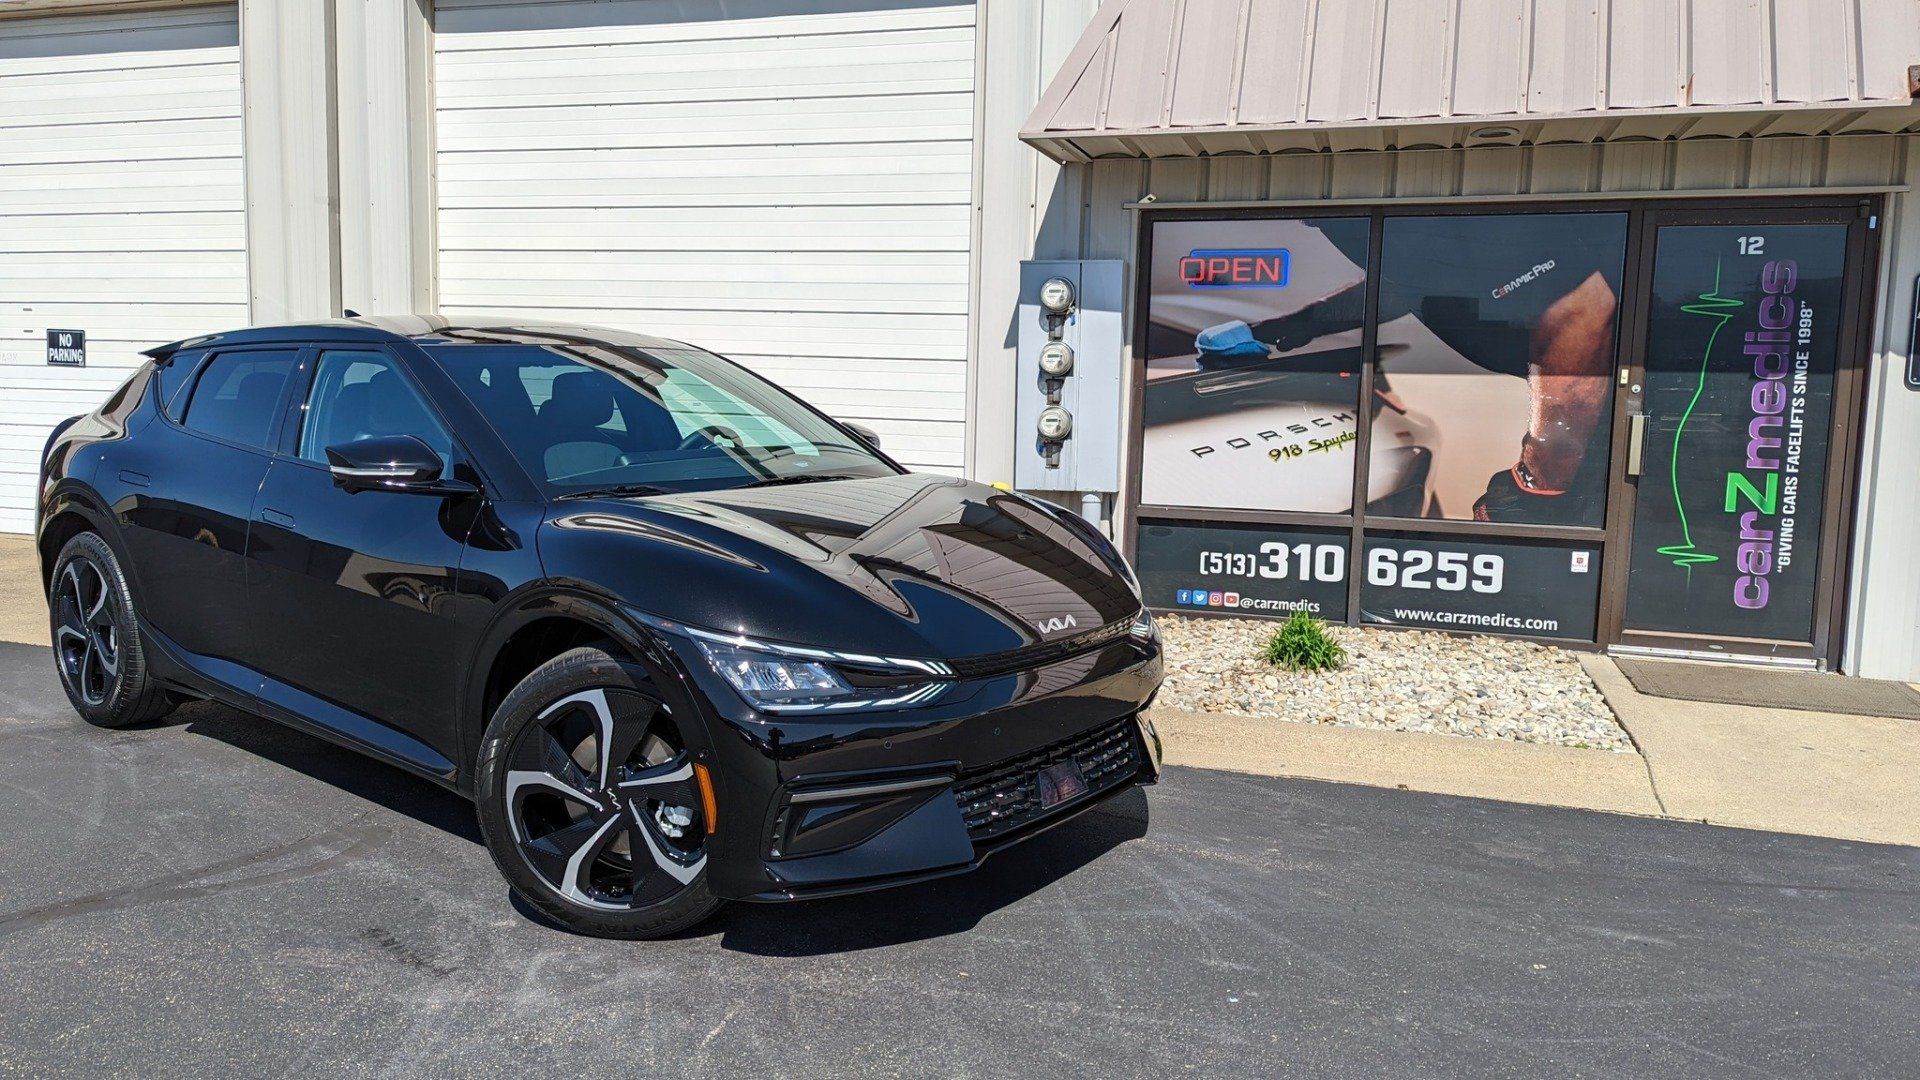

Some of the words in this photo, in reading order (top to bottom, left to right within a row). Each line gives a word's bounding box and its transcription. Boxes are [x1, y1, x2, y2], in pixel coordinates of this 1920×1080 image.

[1737, 236, 1765, 255] 12
[1179, 257, 1280, 283] OPEN
[59, 333, 72, 347] NO
[48, 347, 83, 362] PARKING
[1793, 350, 1810, 394] SINCE
[1190, 409, 1357, 459] PORSCH
[1786, 396, 1804, 473] FACELIFTS
[1268, 444, 1303, 462] 918
[1782, 474, 1798, 515] CARS
[1259, 541, 1345, 582] 310
[1367, 547, 1504, 594] 6259
[1240, 597, 1320, 613] @carzmedics
[1394, 608, 1558, 631] www.carzmedics.com
